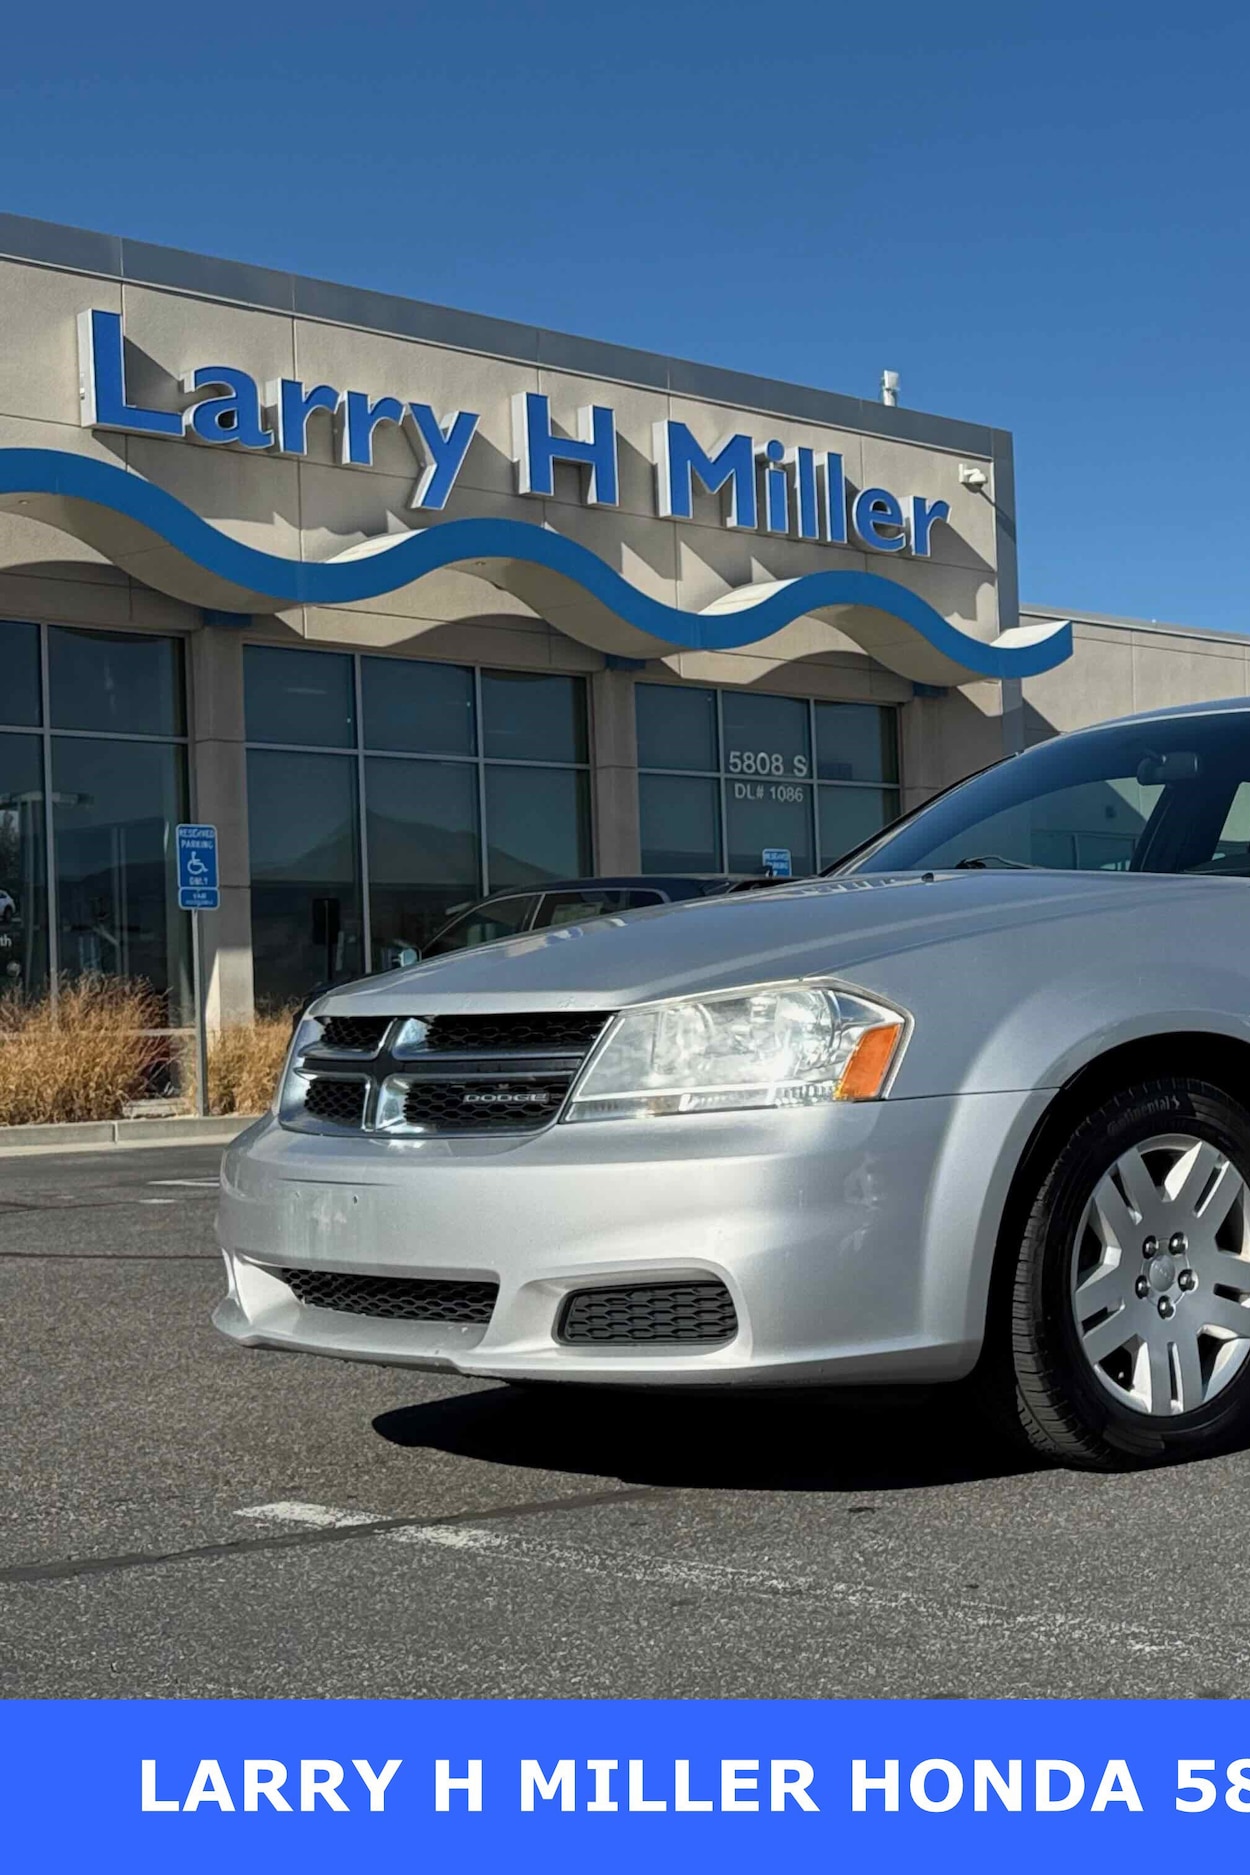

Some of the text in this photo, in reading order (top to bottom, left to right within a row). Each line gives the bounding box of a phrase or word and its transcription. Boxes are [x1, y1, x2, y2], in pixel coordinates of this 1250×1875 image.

[79, 308, 951, 558] Larry H Miller
[729, 751, 807, 777] 5808 S
[734, 783, 804, 802] DL# 1086
[181, 840, 214, 850] PARKING
[464, 1094, 546, 1103] DODGE
